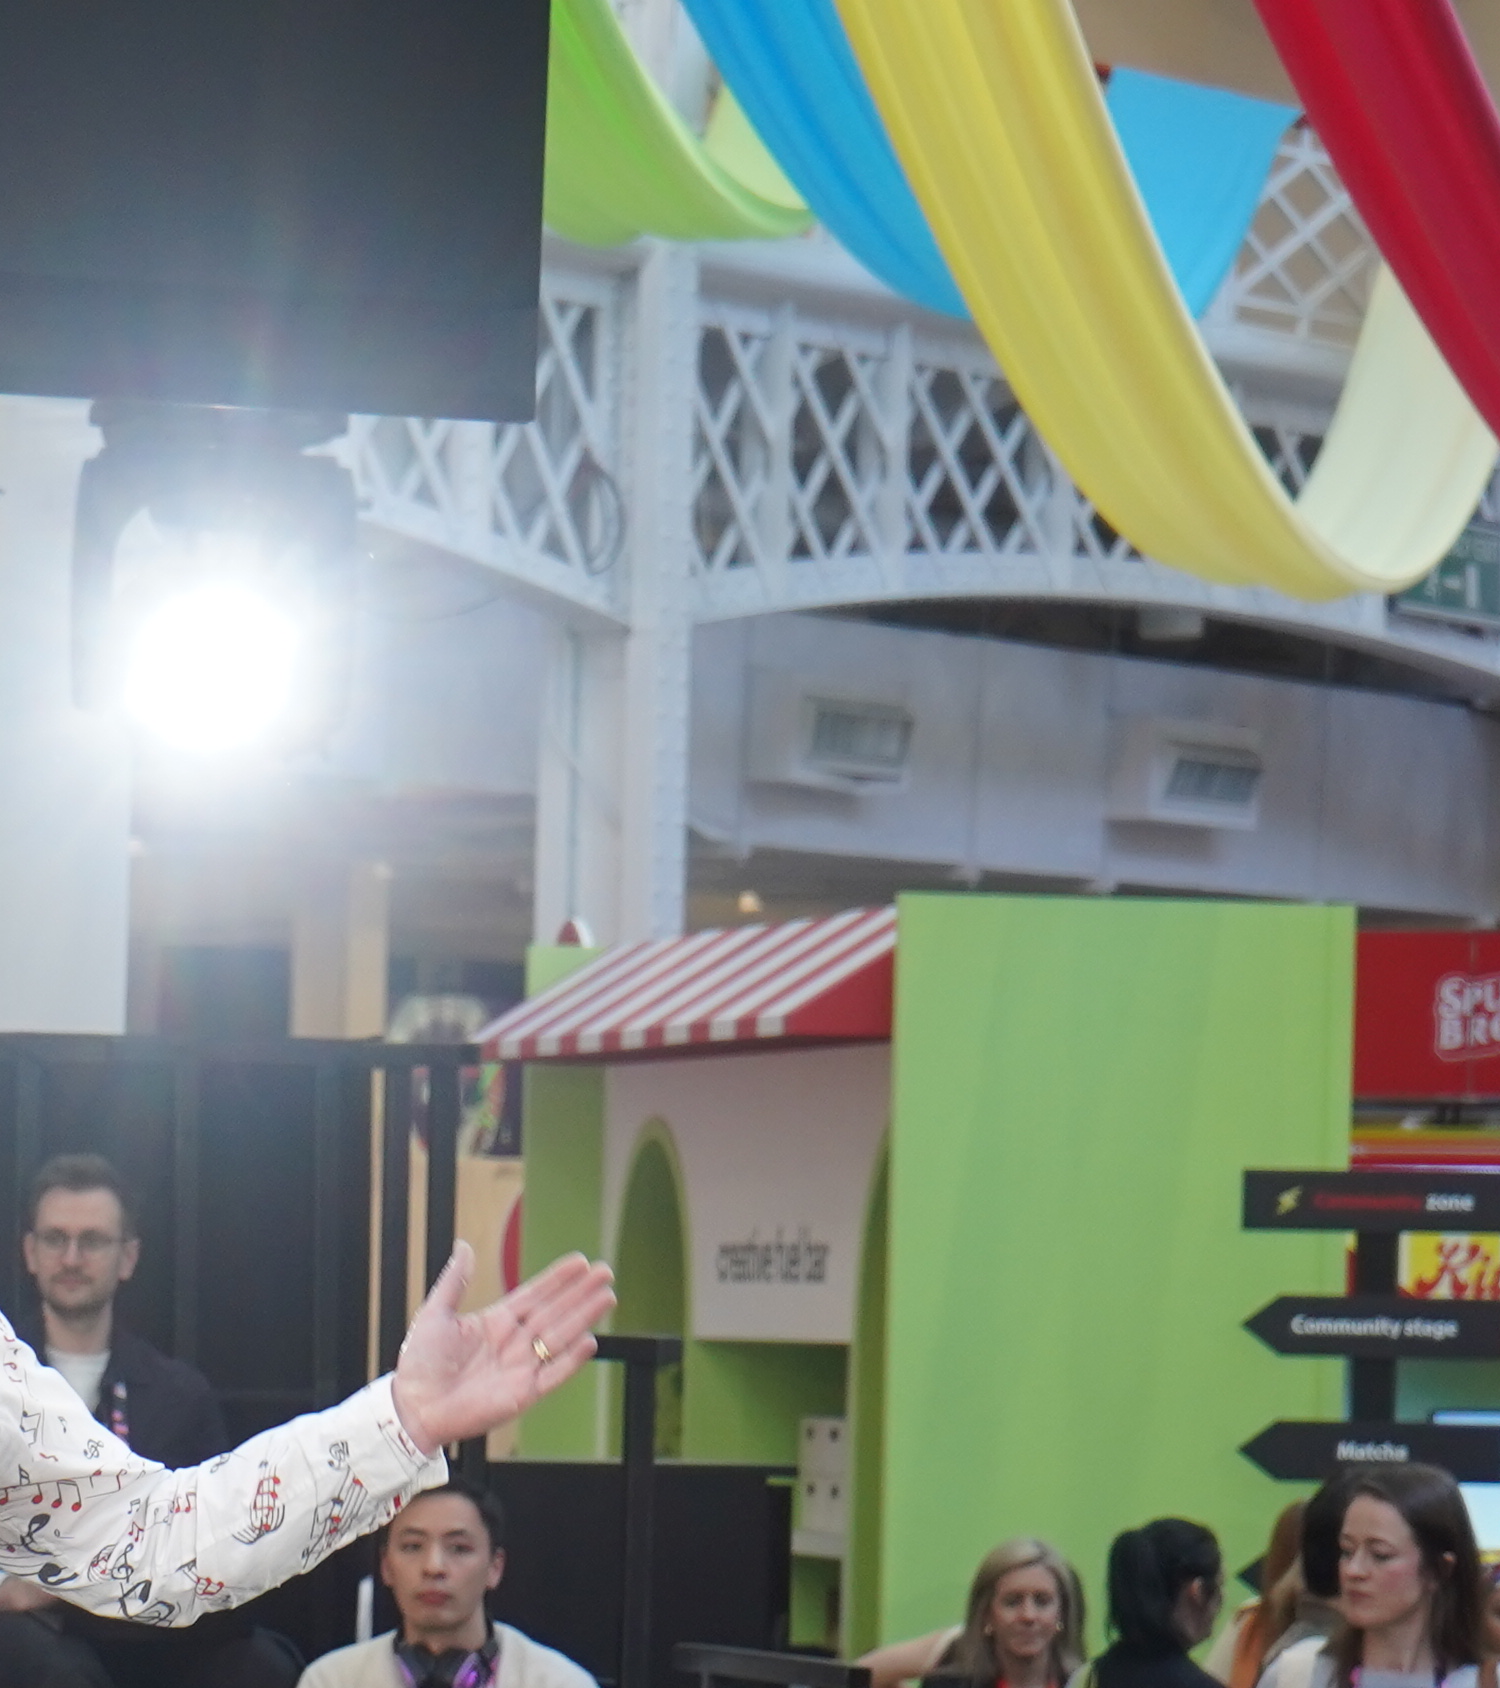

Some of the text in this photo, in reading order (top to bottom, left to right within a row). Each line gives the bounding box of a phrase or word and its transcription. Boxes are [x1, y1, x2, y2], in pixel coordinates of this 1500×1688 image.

[1425, 1193, 1475, 1212] zone
[1290, 1313, 1459, 1341] Community stage
[1336, 1440, 1410, 1463] Matcha
